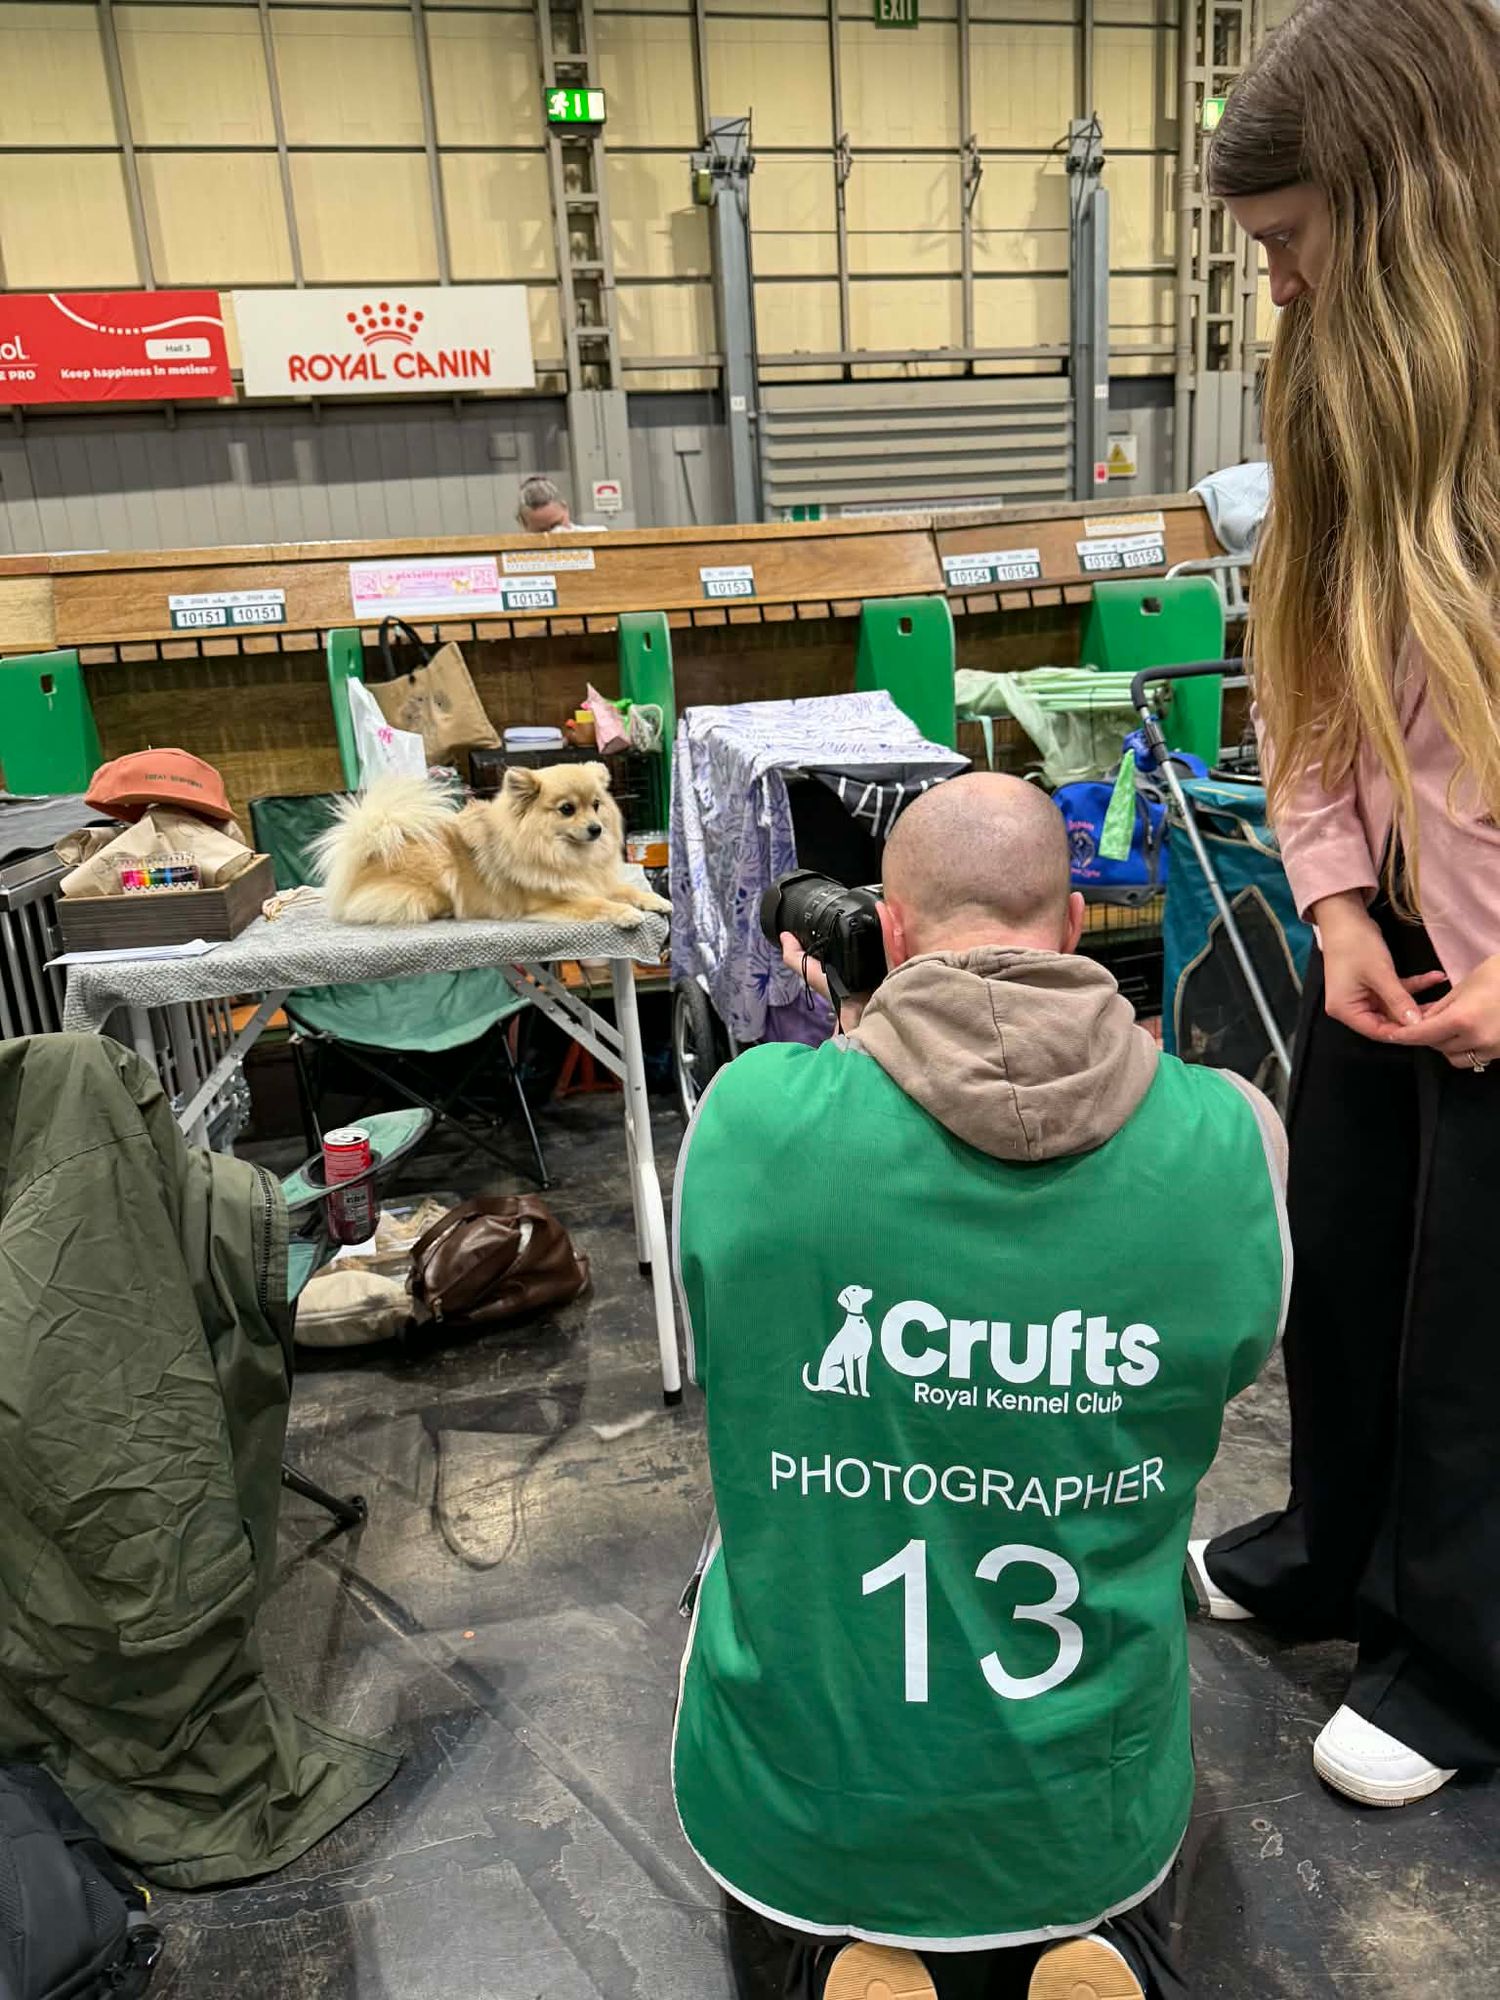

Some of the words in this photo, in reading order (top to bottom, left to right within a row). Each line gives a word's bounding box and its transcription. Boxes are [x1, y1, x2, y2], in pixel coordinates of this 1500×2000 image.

[881, 0, 912, 20] EXIT
[165, 344, 183, 352] Hall
[185, 344, 192, 352] 3
[61, 368, 91, 381] Keep
[93, 366, 152, 380] happiness
[153, 364, 166, 376] in
[168, 363, 210, 376] motion
[288, 353, 387, 382] ROYAL
[393, 349, 491, 379] CANIN
[8, 370, 36, 381] PRO
[1127, 549, 1159, 564] 10155
[1002, 565, 1035, 578] 10154
[512, 592, 549, 606] 10134
[181, 610, 221, 625] 10151
[238, 606, 277, 621] 10151
[880, 1299, 1161, 1387] Crufts
[914, 1382, 978, 1411] Royal
[986, 1388, 1069, 1414] Kennel
[1076, 1392, 1123, 1413] Club
[771, 1450, 1166, 1517] PHOTOGRAPHER
[862, 1538, 1084, 1703] 13
